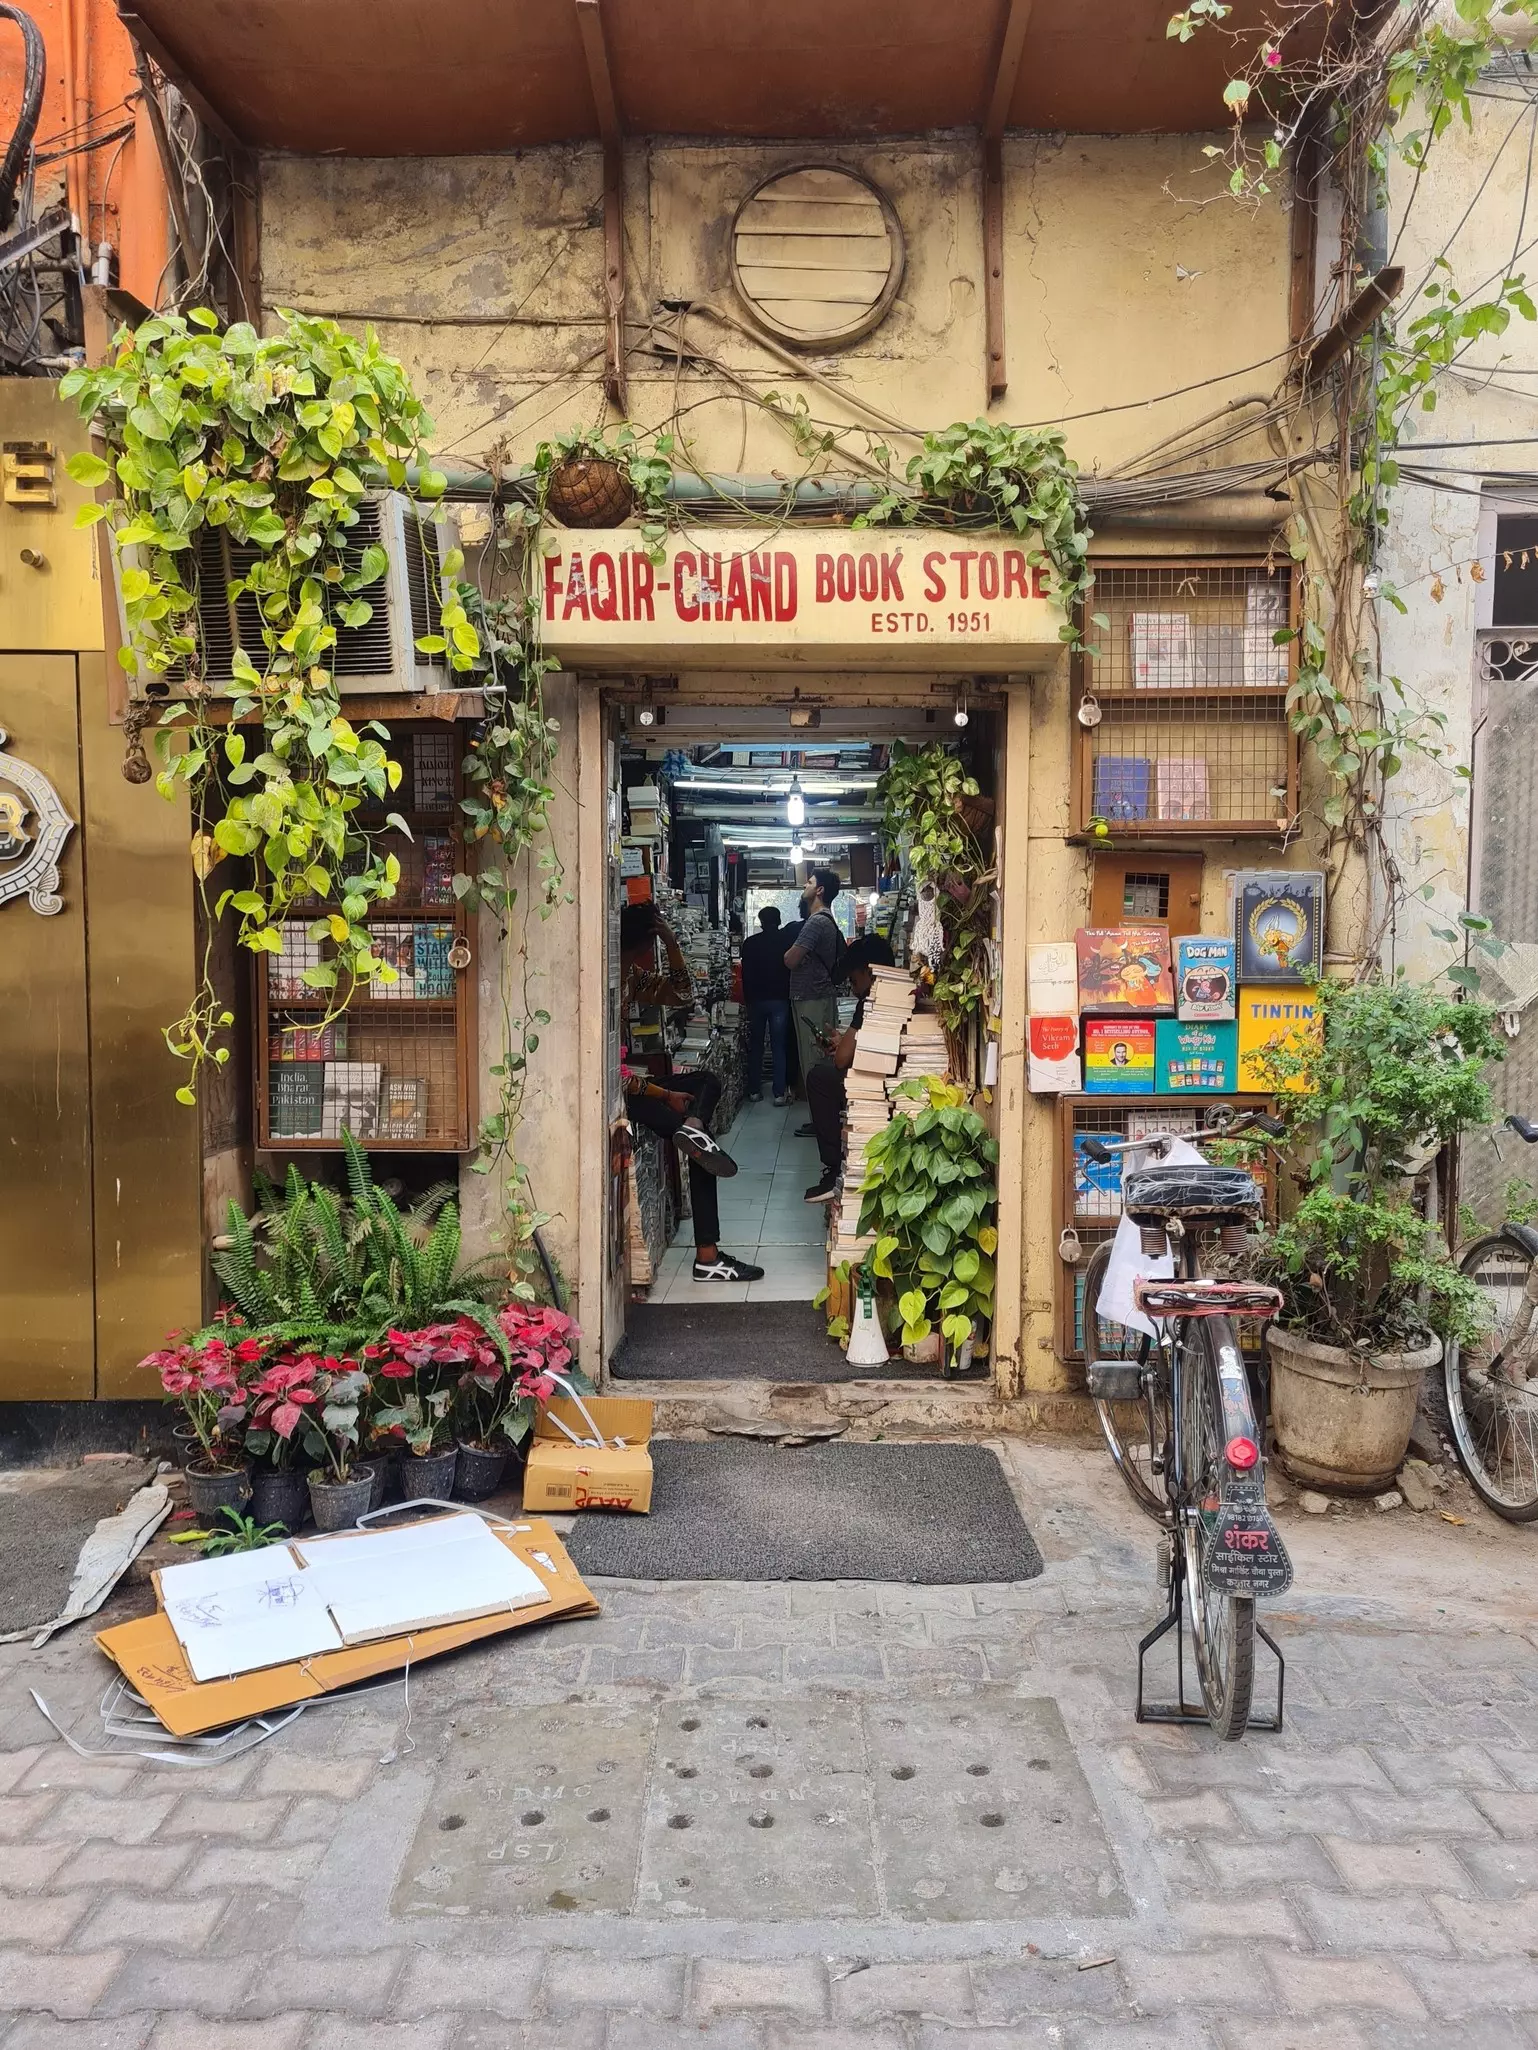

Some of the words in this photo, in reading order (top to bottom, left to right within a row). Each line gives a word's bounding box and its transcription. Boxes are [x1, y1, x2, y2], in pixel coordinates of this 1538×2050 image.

[544, 550, 798, 623] FAQIR-CHAND
[815, 549, 904, 604] BOOK
[923, 549, 1053, 603] STORE
[871, 612, 935, 634] ESTD.
[947, 612, 991, 634] 1951
[1186, 946, 1207, 958] DOG
[1208, 946, 1228, 958] MAN
[1251, 1004, 1314, 1019] TINTIN
[1042, 1033, 1071, 1041] Vikram
[1042, 1041, 1060, 1050] Seth
[272, 1094, 315, 1105] Pakistan
[1225, 1524, 1269, 1550] शंकर
[1257, 1551, 1279, 1563] स्टोर
[1252, 1579, 1270, 1588] नगर
